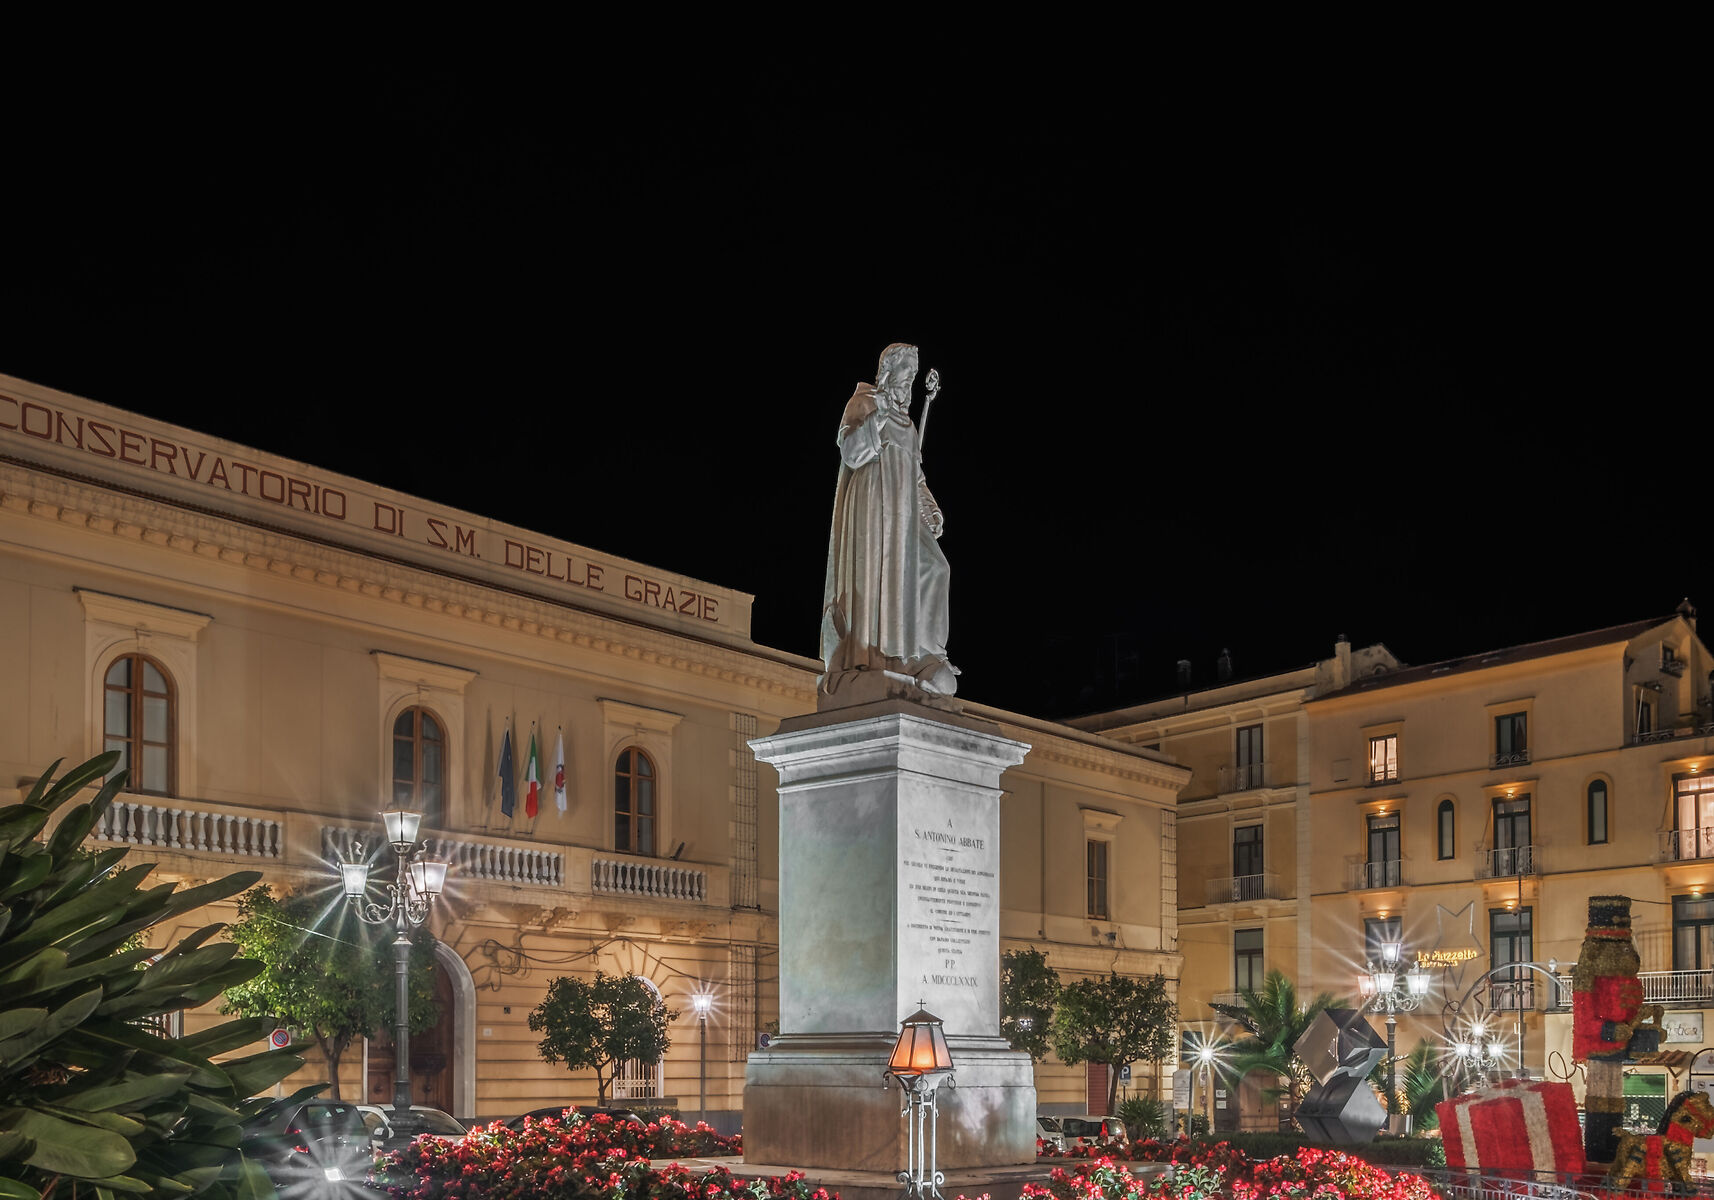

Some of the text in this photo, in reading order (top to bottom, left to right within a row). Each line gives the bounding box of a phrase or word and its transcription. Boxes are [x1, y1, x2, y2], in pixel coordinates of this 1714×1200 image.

[0, 394, 719, 622] CONSERVATORIO DI S.M. DELLE GRAZIE
[947, 818, 953, 828] A
[923, 830, 956, 844] ANTONINO
[958, 837, 985, 850] ABBATE
